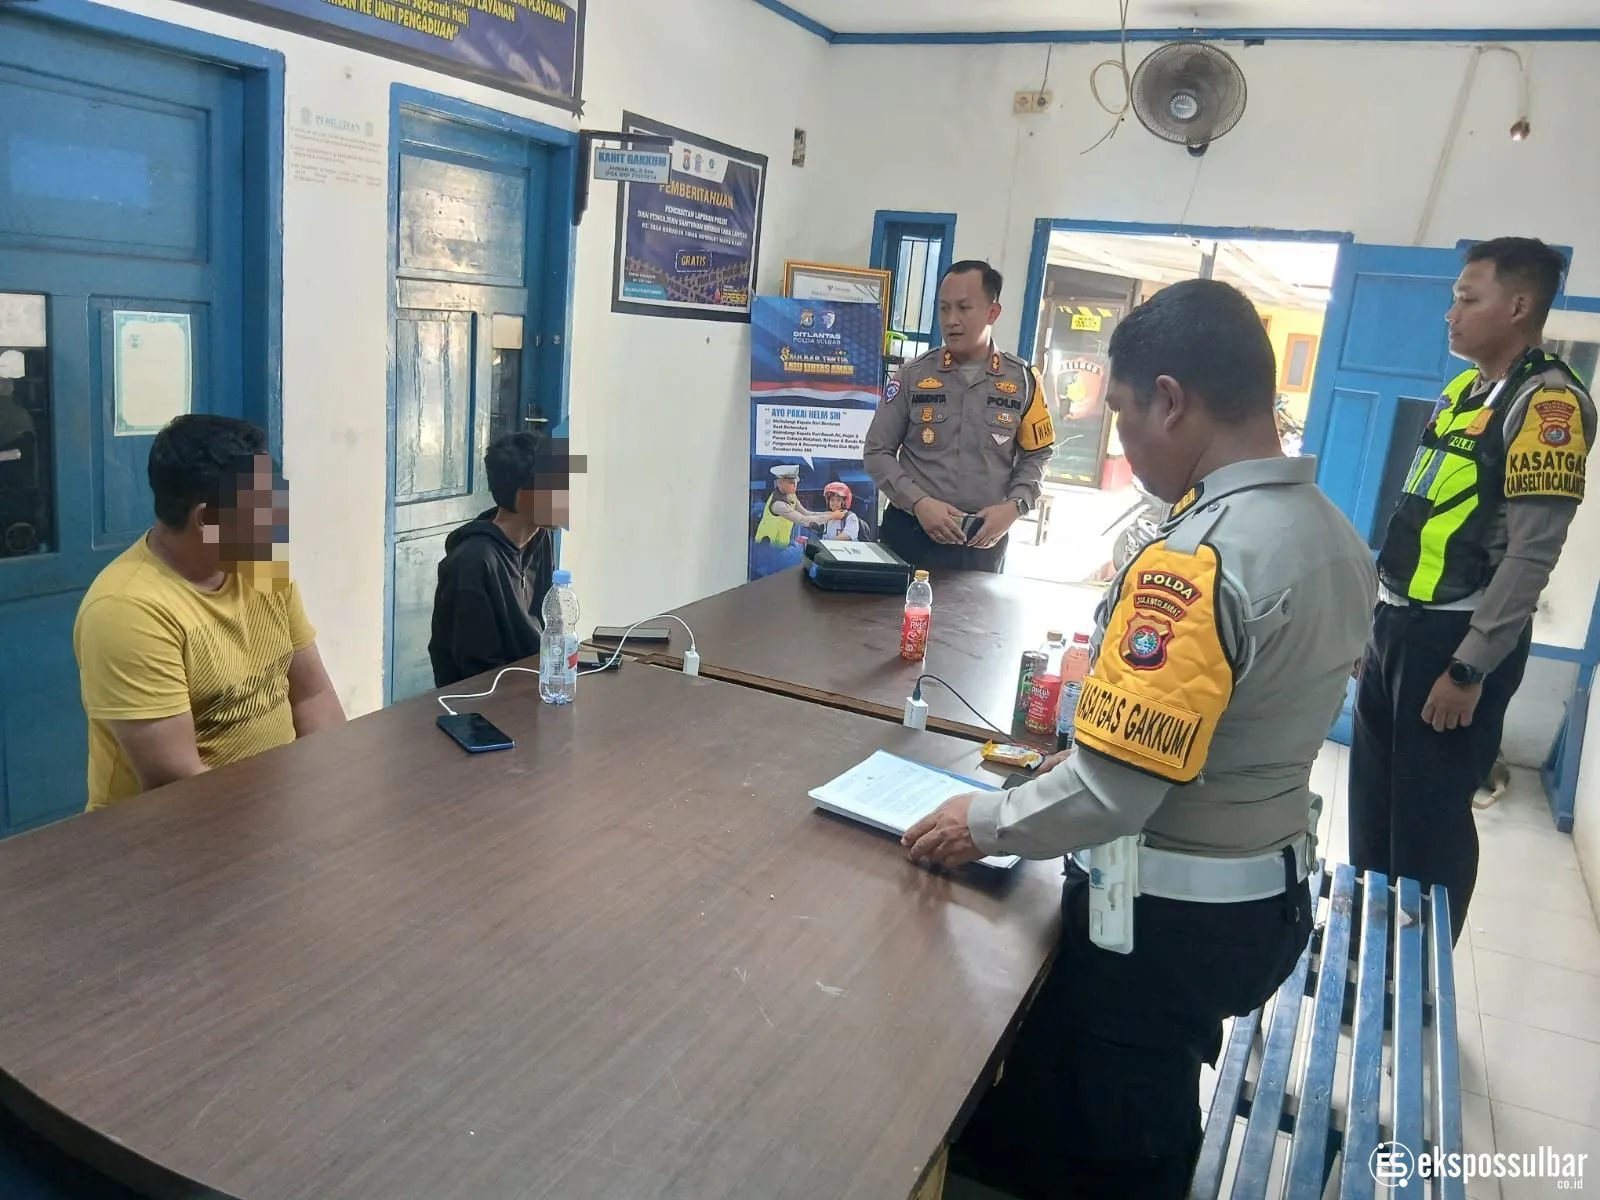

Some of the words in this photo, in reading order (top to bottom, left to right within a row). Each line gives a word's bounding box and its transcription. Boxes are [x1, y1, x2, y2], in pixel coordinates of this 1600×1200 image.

[360, 0, 372, 16] KE
[375, 0, 396, 22] UNIT
[681, 255, 707, 267] GRATIS
[793, 331, 841, 340] DITLANTAS
[987, 395, 1022, 411] POLRI
[772, 408, 785, 417] AYO
[787, 409, 807, 418] PAKAI
[809, 410, 828, 419] HELM
[830, 412, 841, 420] SNI
[1450, 436, 1475, 450] POLRI
[1142, 574, 1194, 600] POLDA
[1077, 681, 1127, 735] KASATGAS
[1124, 703, 1193, 759] GAKKUM
